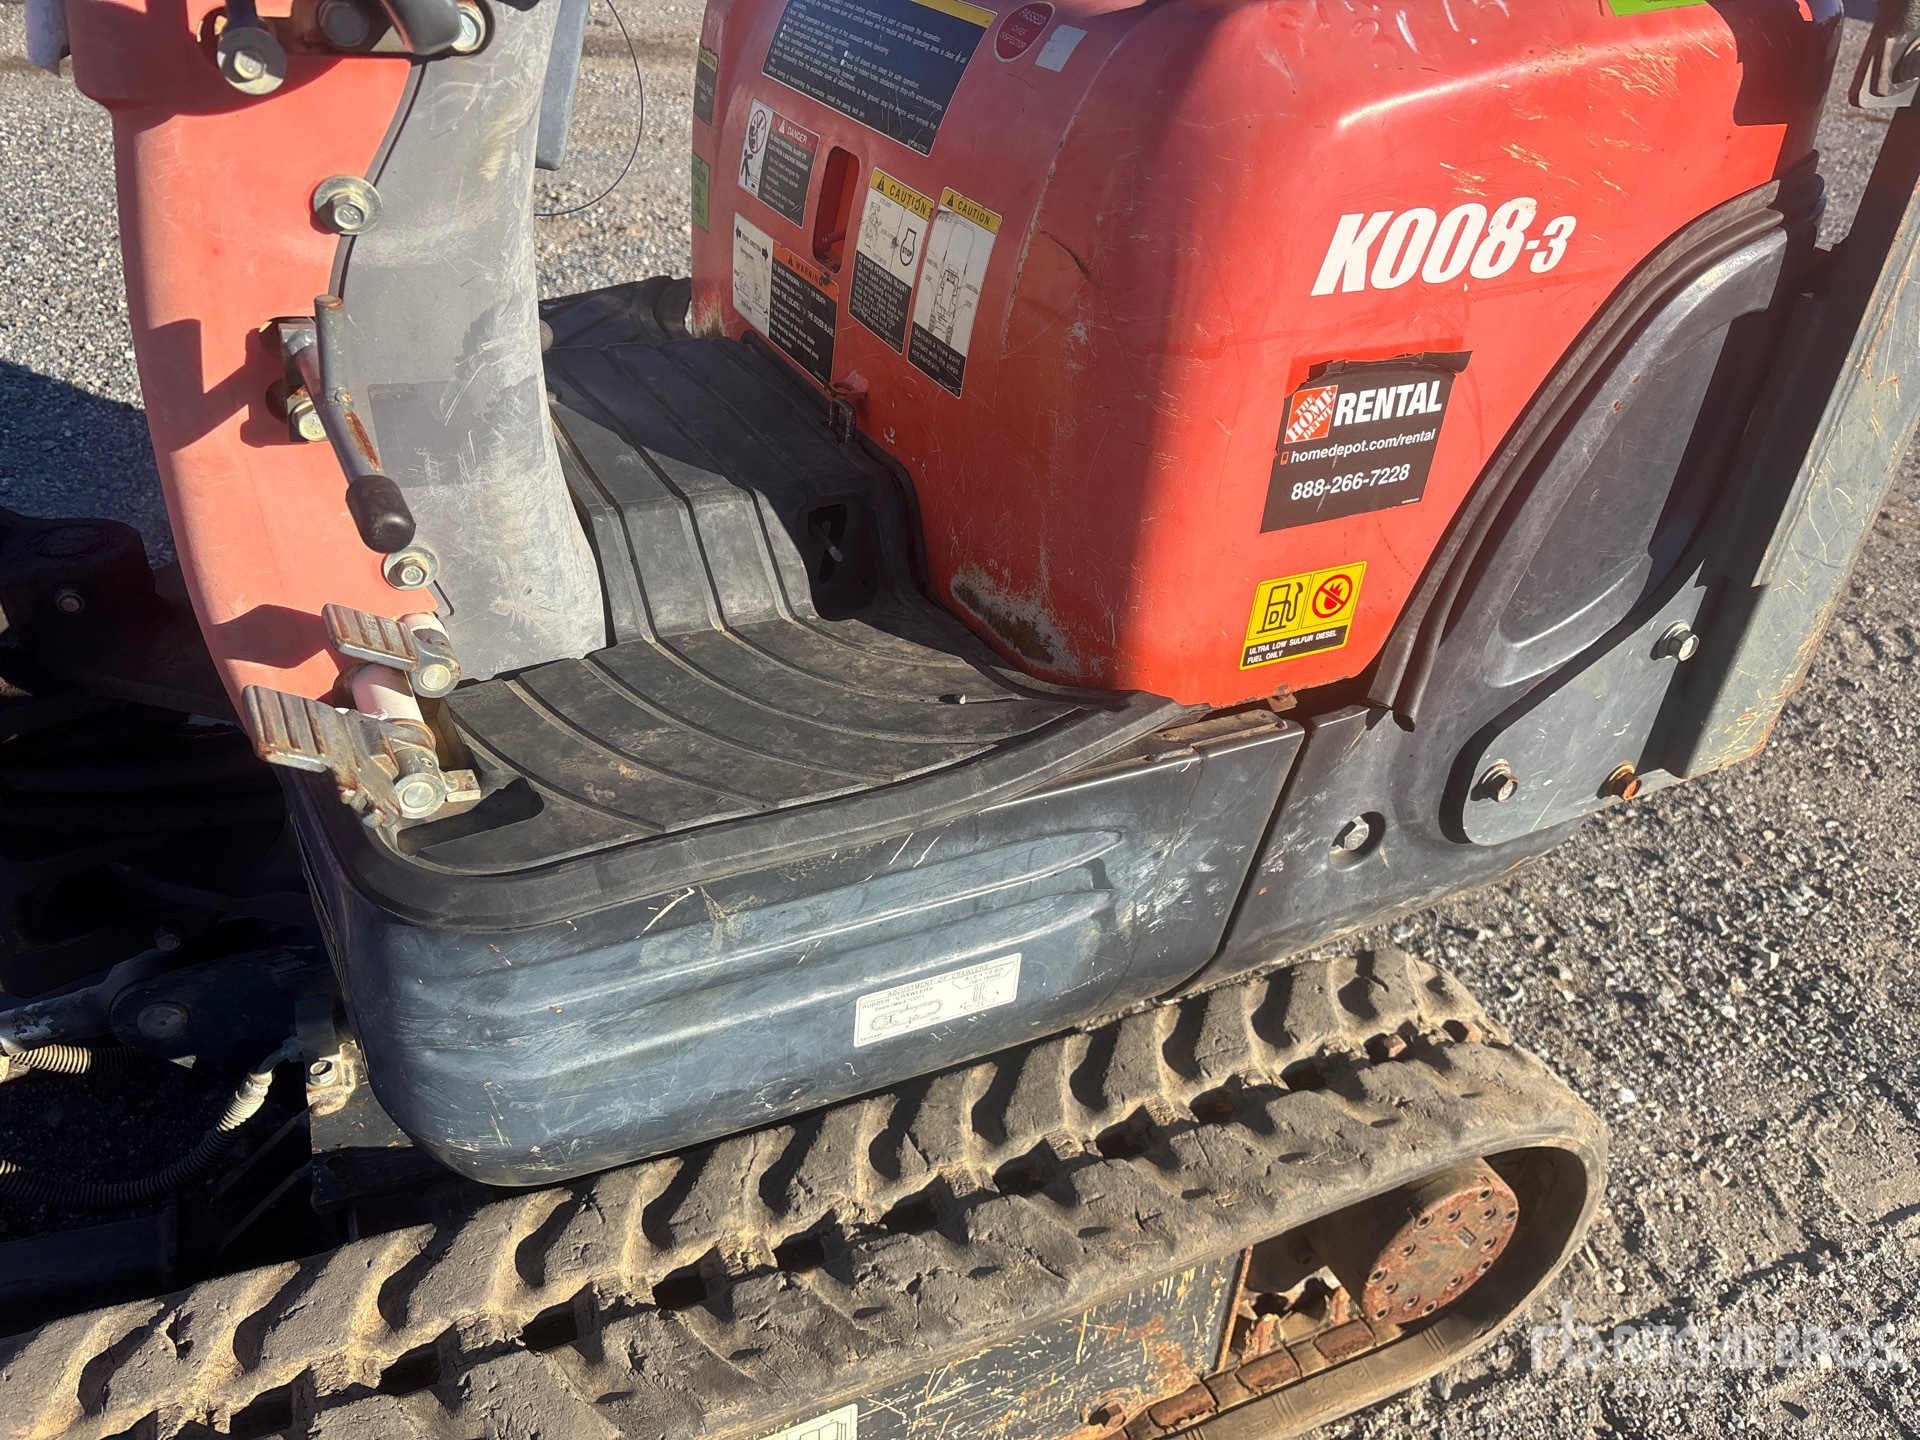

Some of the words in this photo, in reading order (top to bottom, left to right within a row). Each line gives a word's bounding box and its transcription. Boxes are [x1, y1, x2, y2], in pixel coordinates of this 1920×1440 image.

[1017, 7, 1046, 25] PASSED
[787, 126, 807, 144] DANGER
[889, 184, 927, 214] CAUTION
[957, 201, 990, 225] CAUTION
[902, 246, 912, 258] STOP
[1310, 197, 1577, 297] K008-3
[795, 261, 822, 286] WARNING
[1285, 387, 1337, 441] HOME
[1295, 394, 1315, 416] THE
[1333, 380, 1443, 427] RENTAL
[1302, 406, 1333, 440] DEPOT
[1290, 428, 1437, 464] homedepot.com/rental
[1290, 463, 1411, 501] 888-266-7228
[1268, 610, 1280, 625] D
[1248, 643, 1270, 655] ULTRA
[1271, 640, 1288, 651] LOW
[1288, 634, 1314, 647] SULFUR
[1315, 629, 1338, 640] DIESEL
[1246, 654, 1263, 665] FUEL
[1265, 649, 1284, 661] ONLY
[887, 980, 933, 997] ADJUSTMENT
[938, 975, 946, 983] OF
[951, 964, 988, 979] CRAWLERS
[862, 997, 889, 1009] RUBBER
[895, 986, 933, 1000] CRAWLERS
